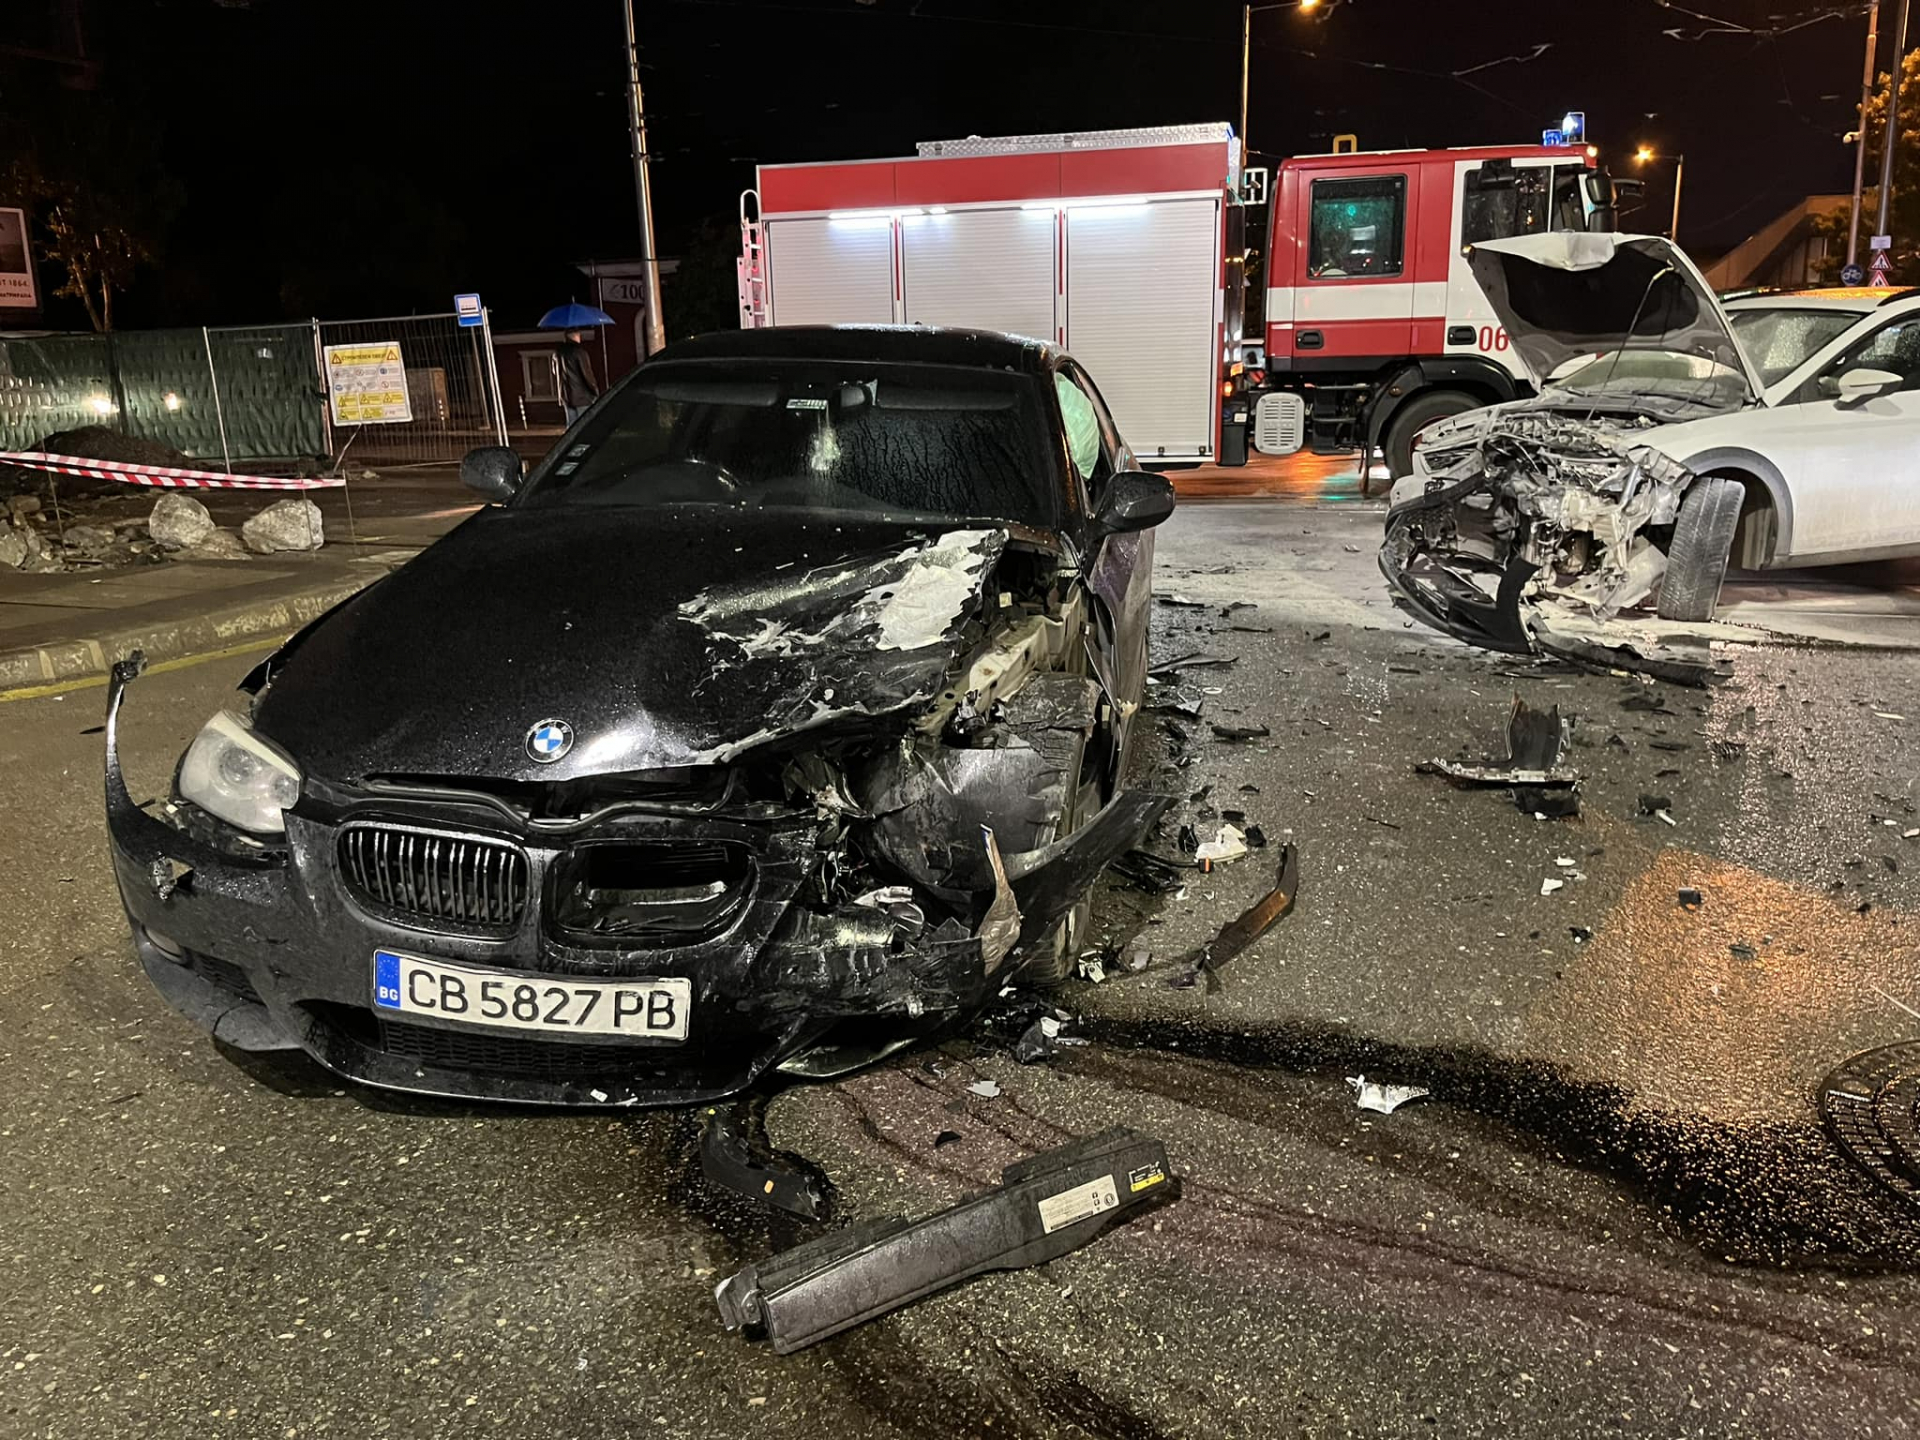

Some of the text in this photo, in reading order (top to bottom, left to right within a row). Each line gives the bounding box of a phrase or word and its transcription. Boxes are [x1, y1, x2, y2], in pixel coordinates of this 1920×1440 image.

[1479, 326, 1509, 352] 06
[379, 986, 398, 1001] BG
[408, 969, 676, 1031] CB 5827 PB
